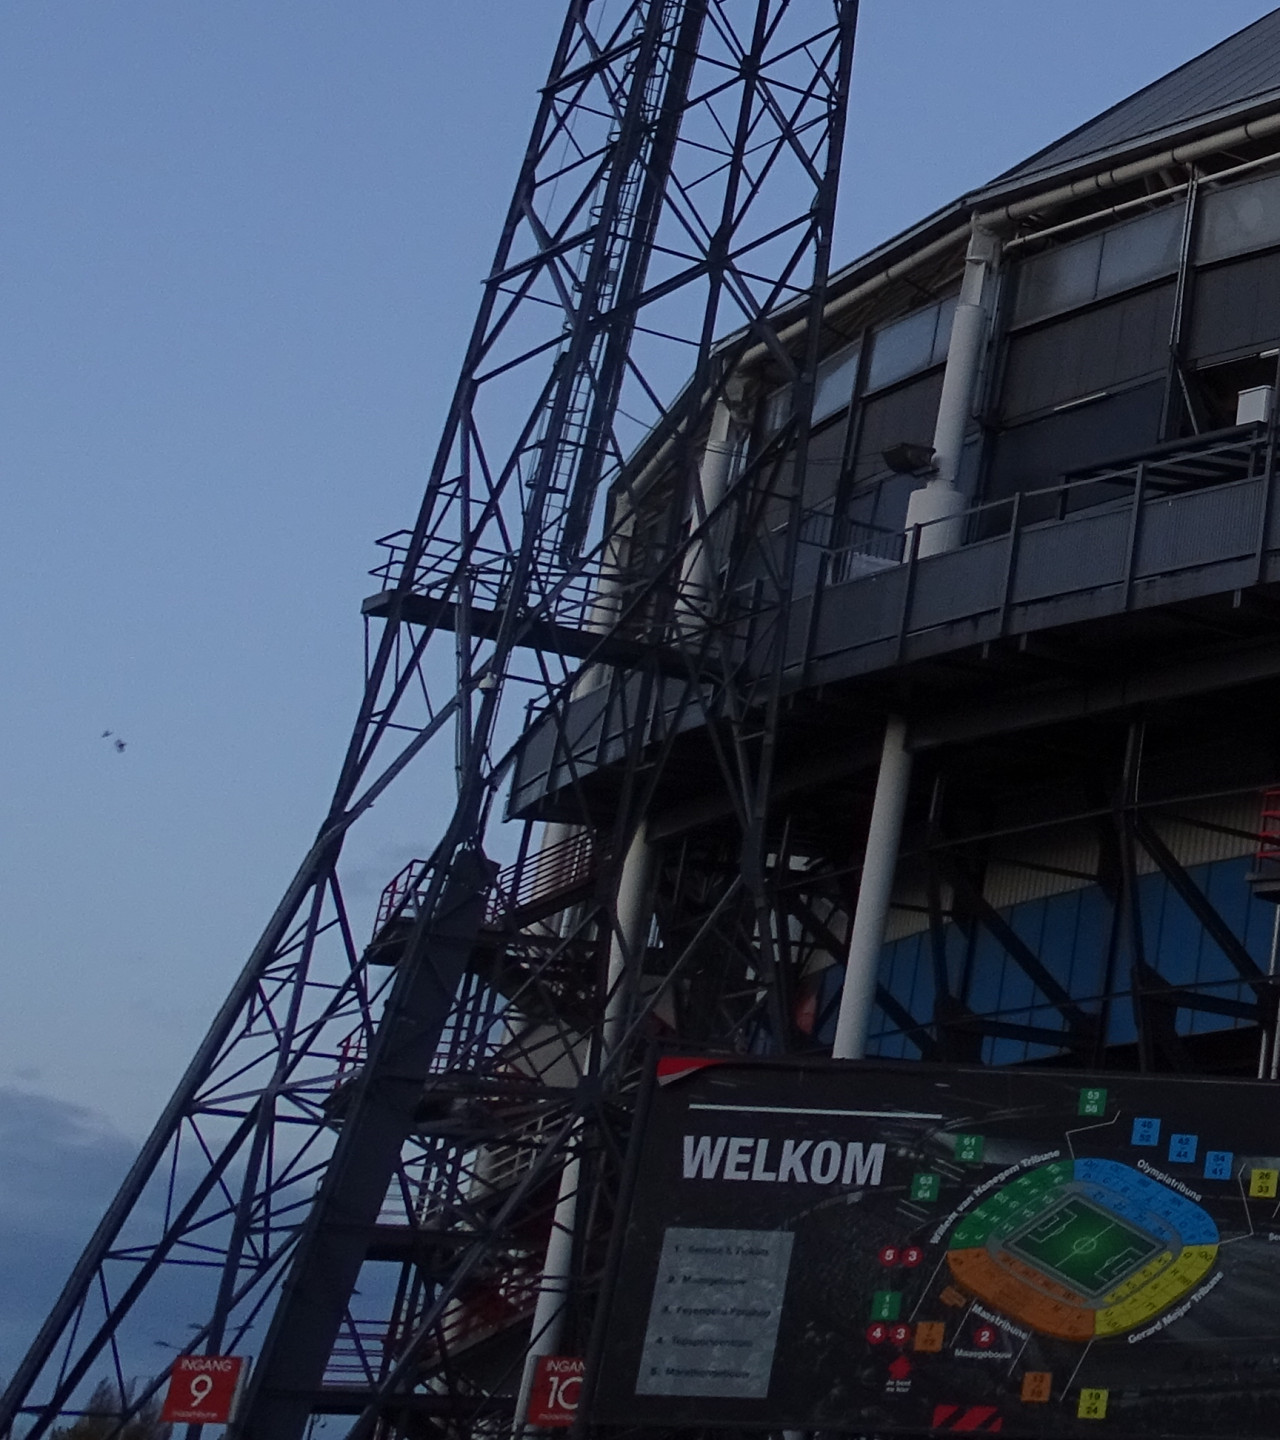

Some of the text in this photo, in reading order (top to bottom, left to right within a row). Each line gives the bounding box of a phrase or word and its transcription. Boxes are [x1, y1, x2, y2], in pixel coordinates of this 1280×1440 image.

[682, 1135, 887, 1186] WELKOM
[1137, 1159, 1203, 1202] Olympiatribune
[885, 1250, 894, 1260] 5
[908, 1251, 917, 1261] 3
[872, 1328, 882, 1338] 4
[896, 1328, 906, 1339] 3
[980, 1331, 990, 1342] 2
[1128, 1321, 1163, 1344] Gerard
[181, 1358, 232, 1372] INGANG
[546, 1360, 586, 1372] INGAN
[191, 1373, 213, 1407] 9
